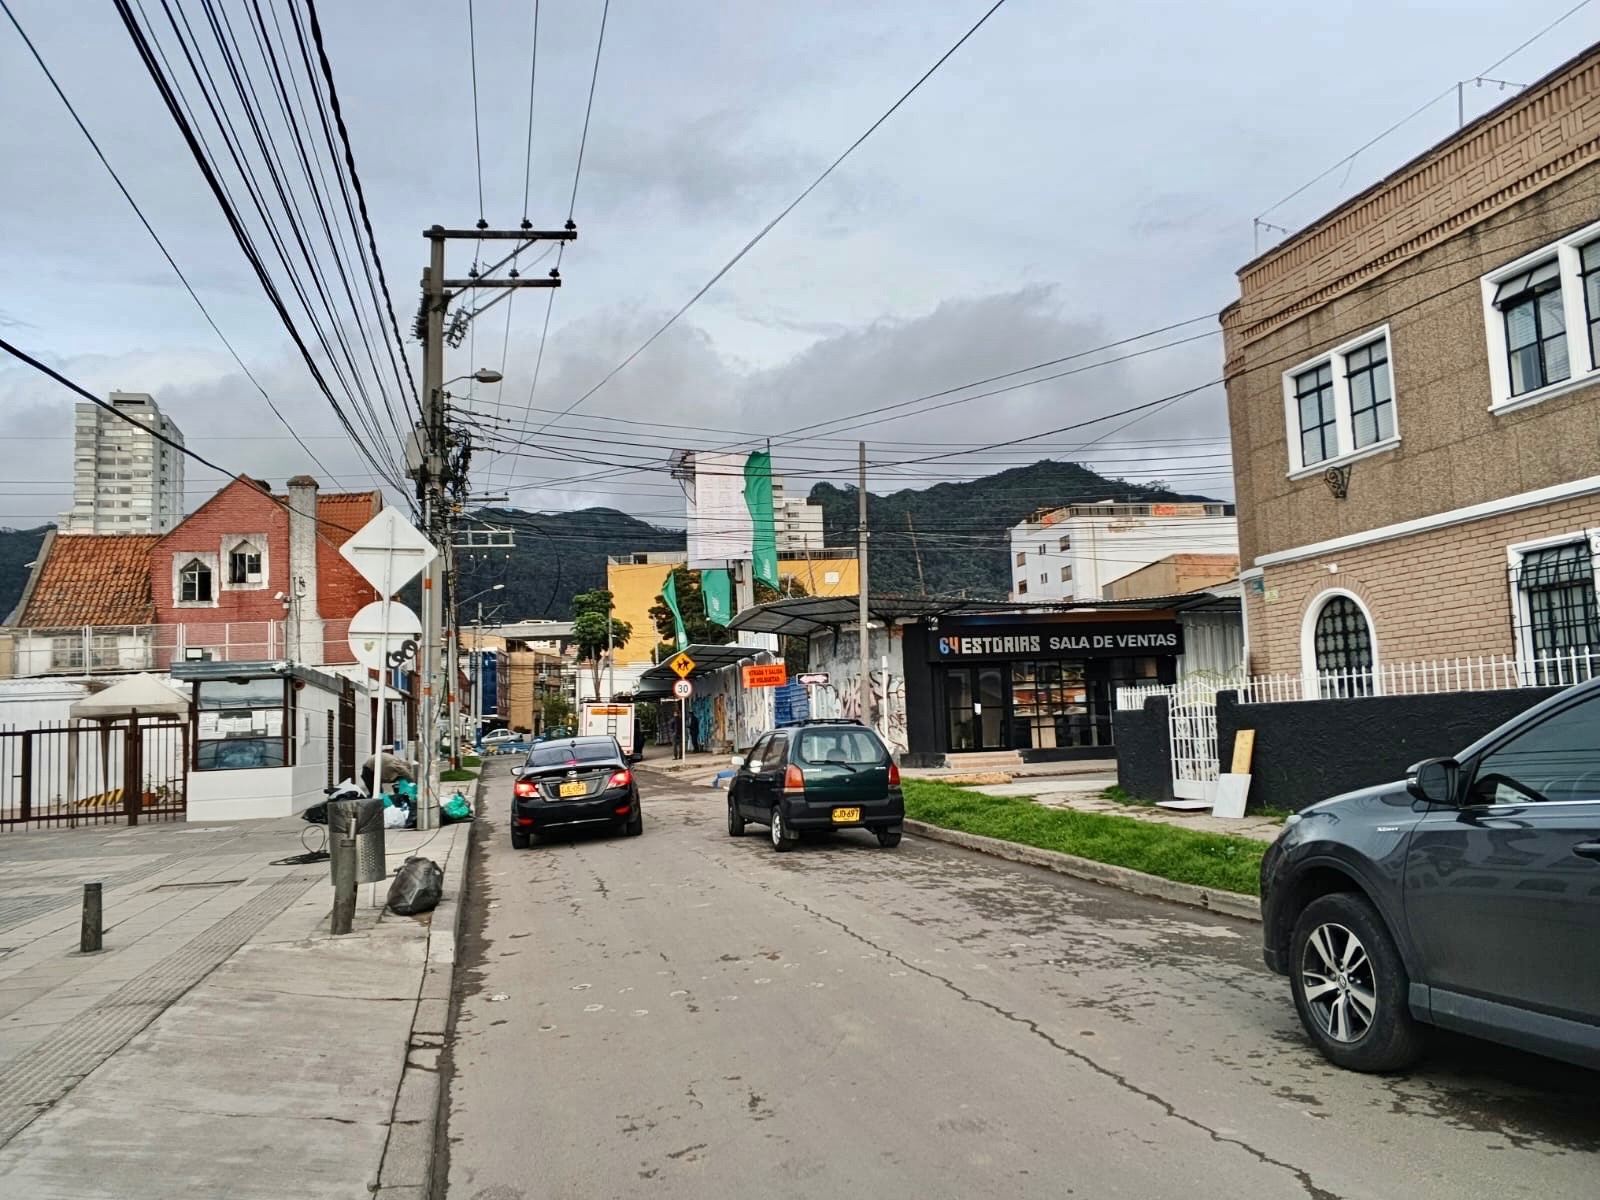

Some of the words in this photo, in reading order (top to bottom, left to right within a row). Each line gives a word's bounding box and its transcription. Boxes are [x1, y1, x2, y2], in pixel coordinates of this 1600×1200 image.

[939, 636, 959, 654] 64
[1049, 636, 1090, 650] SALA
[1093, 635, 1114, 648] DE
[1116, 633, 1177, 647] VENTAS
[677, 684, 689, 693] 30
